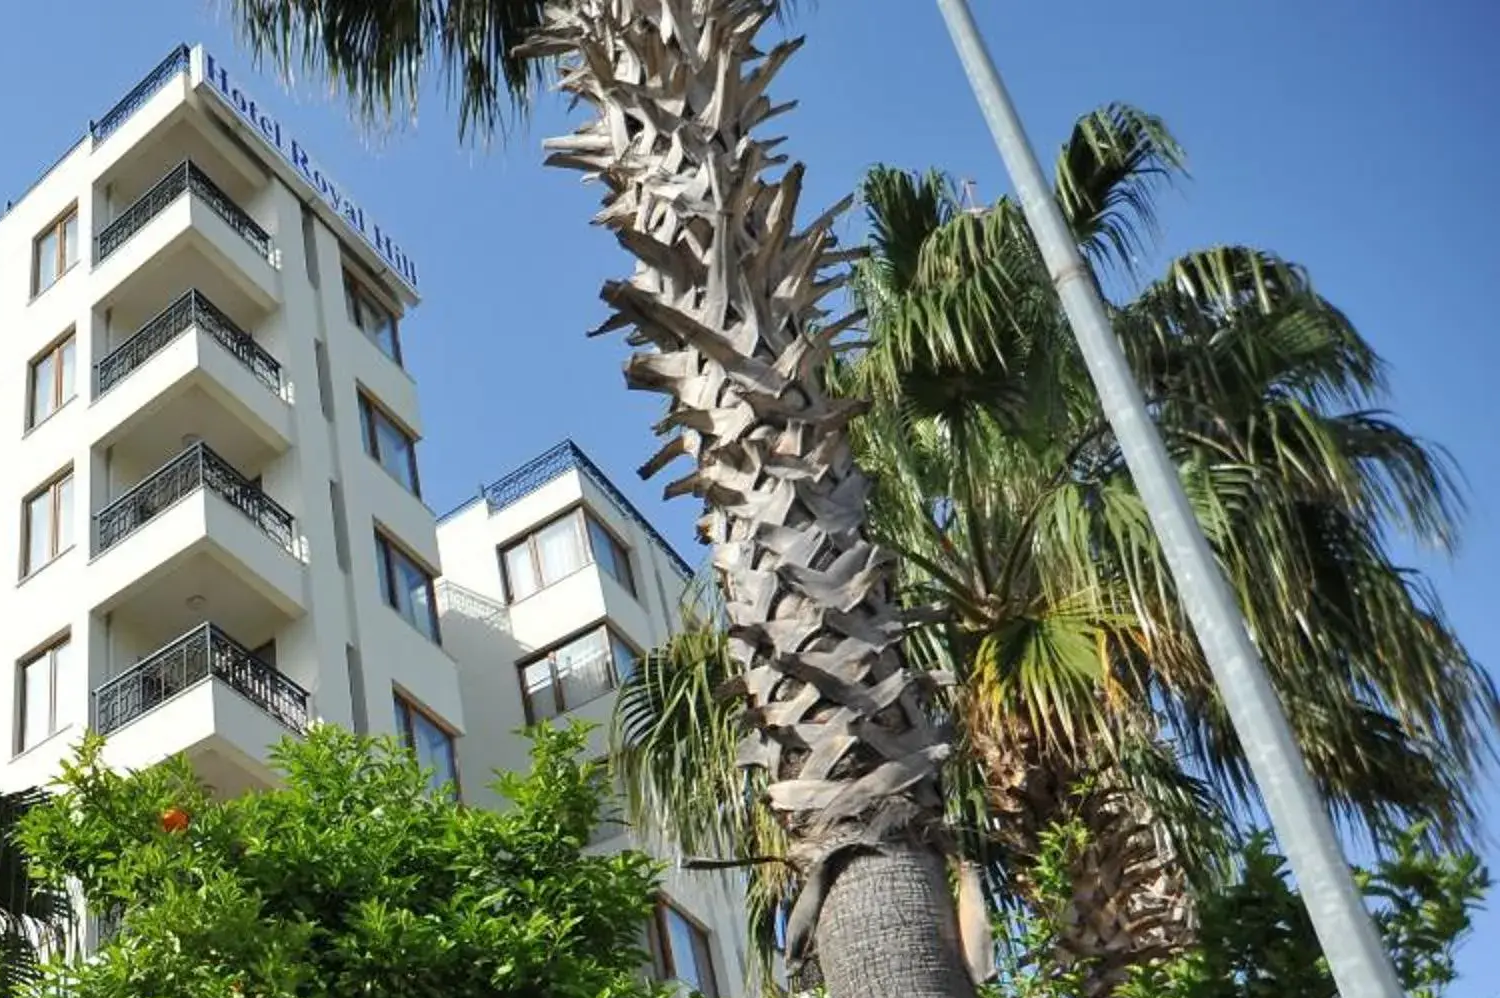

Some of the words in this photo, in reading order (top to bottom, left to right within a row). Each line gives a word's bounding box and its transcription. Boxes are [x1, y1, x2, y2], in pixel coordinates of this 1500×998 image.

[207, 54, 282, 148] Hotel
[291, 139, 365, 233] Royal
[373, 224, 418, 286] Hill
